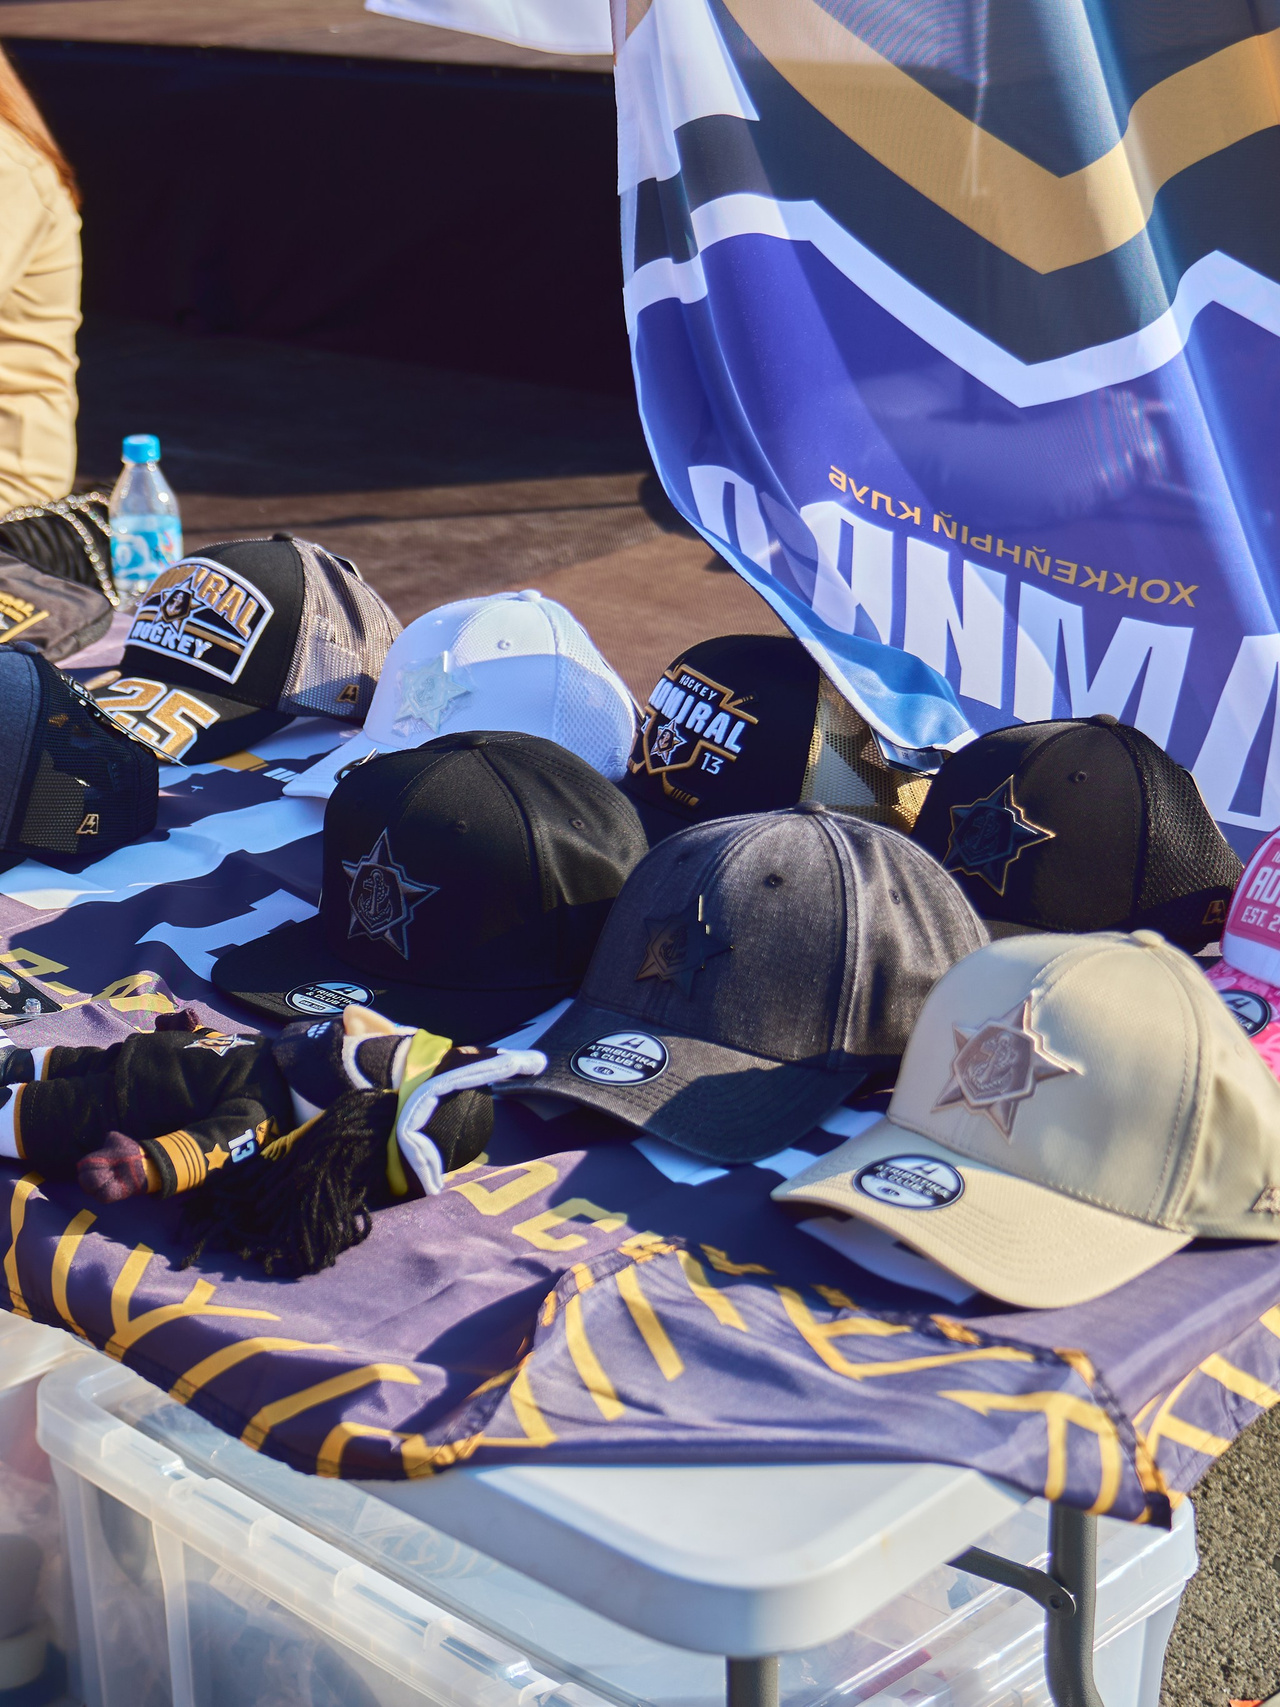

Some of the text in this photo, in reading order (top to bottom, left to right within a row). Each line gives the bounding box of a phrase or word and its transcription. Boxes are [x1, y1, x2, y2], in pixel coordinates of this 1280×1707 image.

[131, 620, 213, 660] HOCKEY
[678, 674, 718, 701] HOCKEY
[95, 677, 221, 763] 25
[699, 751, 725, 776] 13
[1241, 905, 1265, 928] EST.
[314, 993, 340, 1005] CLUB
[586, 1044, 658, 1069] ATRIBUTIKA
[600, 1052, 634, 1067] CLUB
[227, 1128, 255, 1164] 13
[873, 1163, 952, 1200] ATRIBUTIKA
[888, 1174, 923, 1192] CLUB
